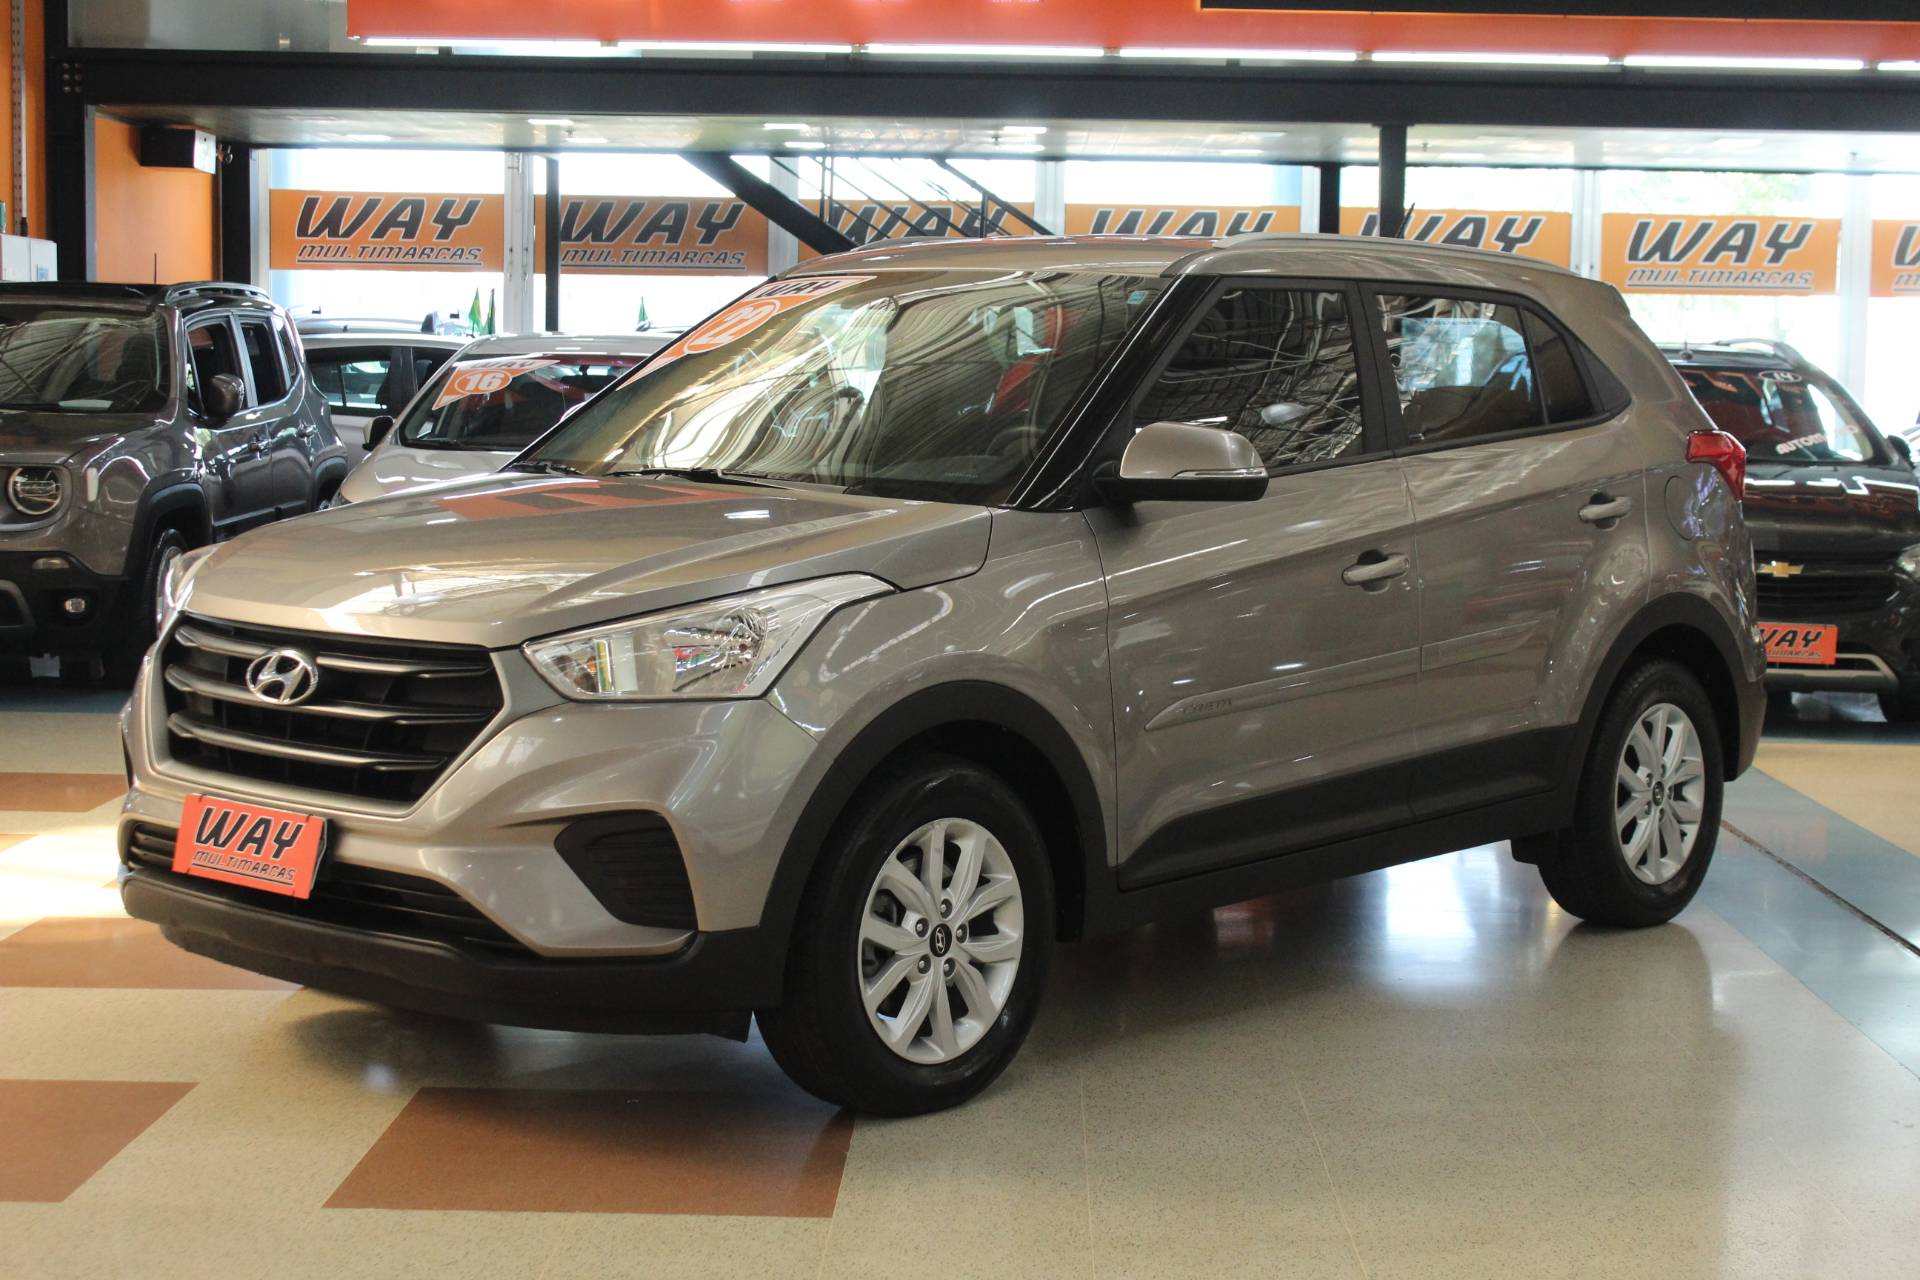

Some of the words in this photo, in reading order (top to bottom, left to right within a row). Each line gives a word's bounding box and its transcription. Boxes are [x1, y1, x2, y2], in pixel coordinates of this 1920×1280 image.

[296, 195, 484, 241] WAY
[560, 201, 747, 245] WAY
[297, 244, 483, 261] MULTIMARCAS
[561, 248, 746, 265] MULTIMARCAS
[1625, 219, 1815, 266] WAY
[1626, 268, 1813, 286] MULTIMARCAS
[464, 372, 506, 392] 16
[194, 806, 305, 861] WAY
[193, 850, 296, 881] MULTIMARCAS
